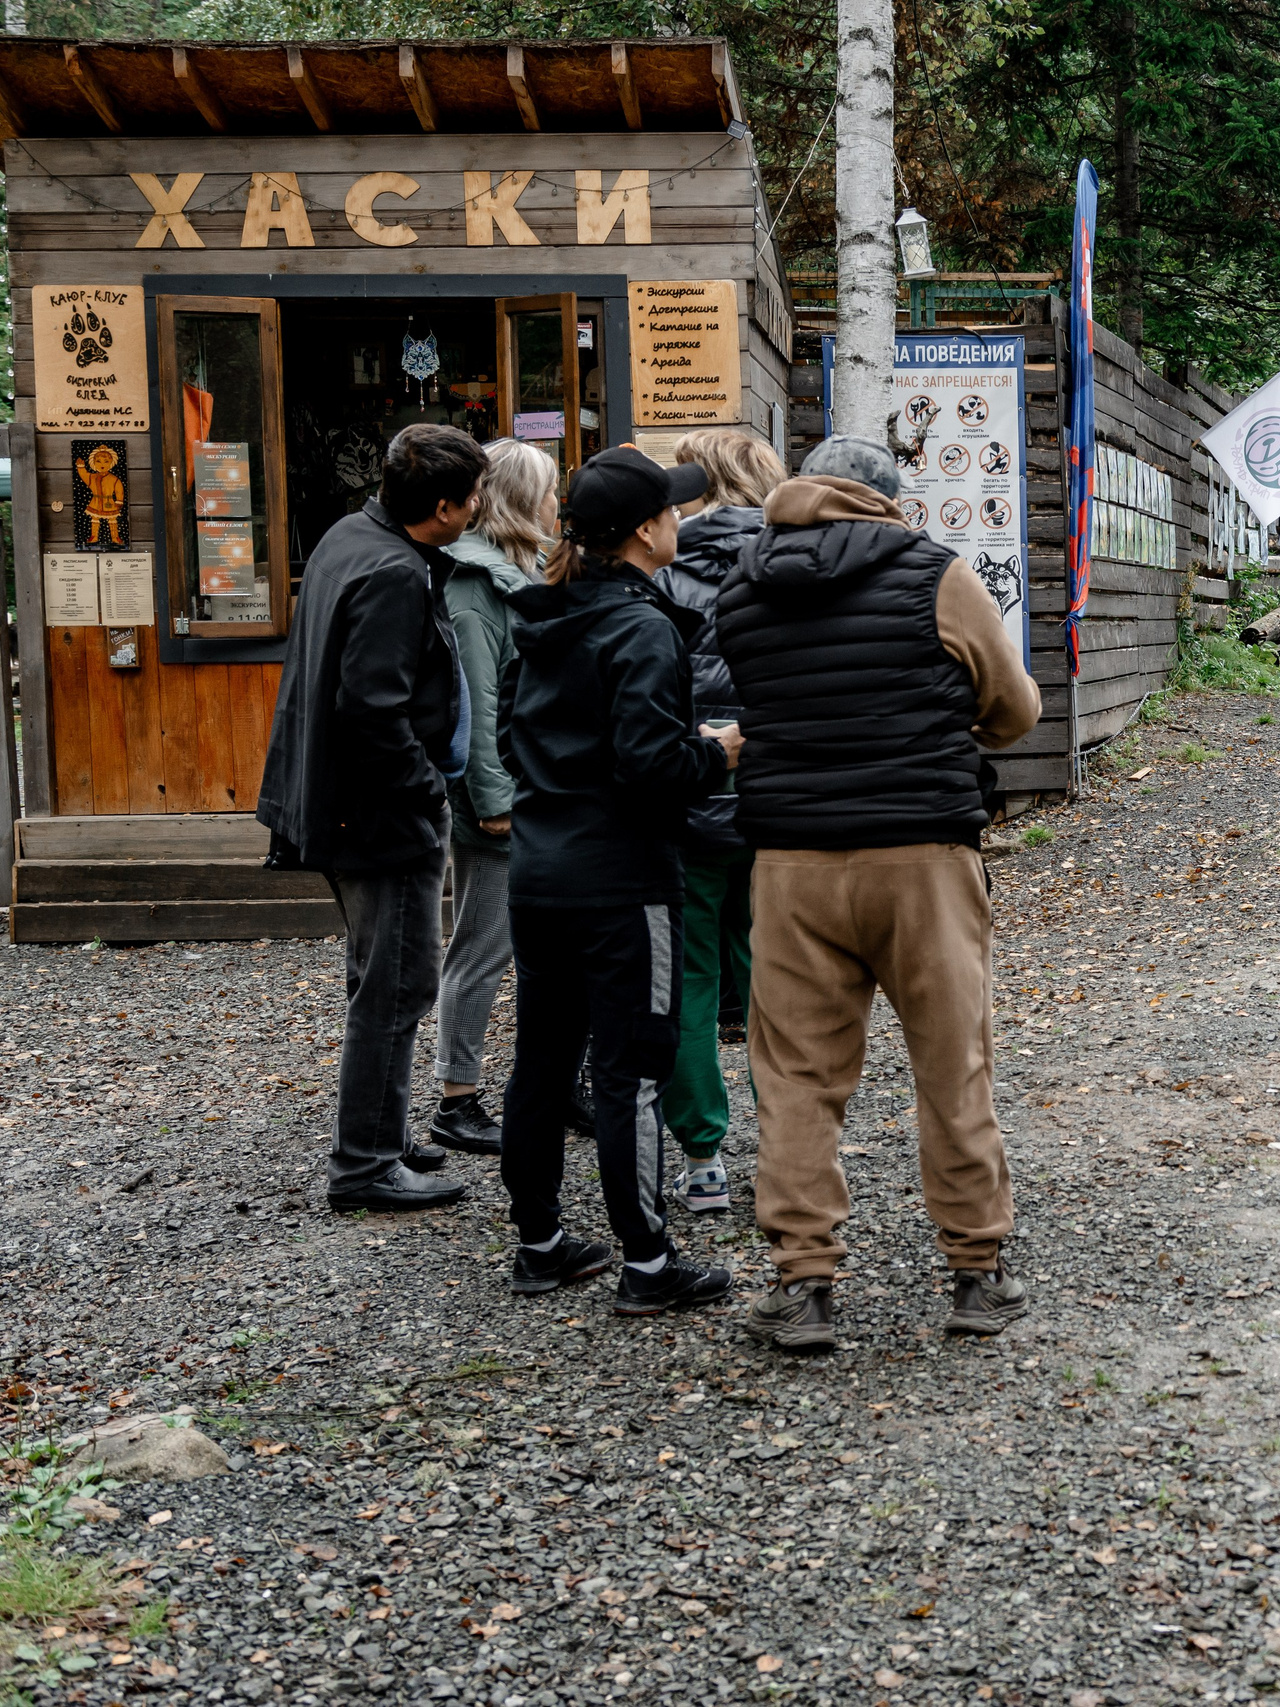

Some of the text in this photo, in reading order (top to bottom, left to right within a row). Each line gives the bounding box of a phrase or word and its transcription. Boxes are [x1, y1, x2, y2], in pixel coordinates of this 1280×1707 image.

[129, 170, 653, 249] ХАСКИ
[50, 290, 128, 307] КАЮР-КЛУБ
[647, 287, 705, 298] Экскурсии
[648, 304, 719, 316] Догтрекинг
[650, 322, 719, 332] Катание на
[653, 341, 701, 352] упряжке
[915, 344, 1015, 364] ПОВЕДЕНИЯ
[651, 356, 691, 370] Аренда
[654, 375, 720, 387] снаряжения
[895, 374, 1013, 390] НАС ЗАПРЕЩАЕТСЯ!
[653, 391, 727, 403] Библиотечка
[653, 410, 718, 421] Хаски-шоп
[514, 420, 564, 431] РЕГИСТРАЦИЯ
